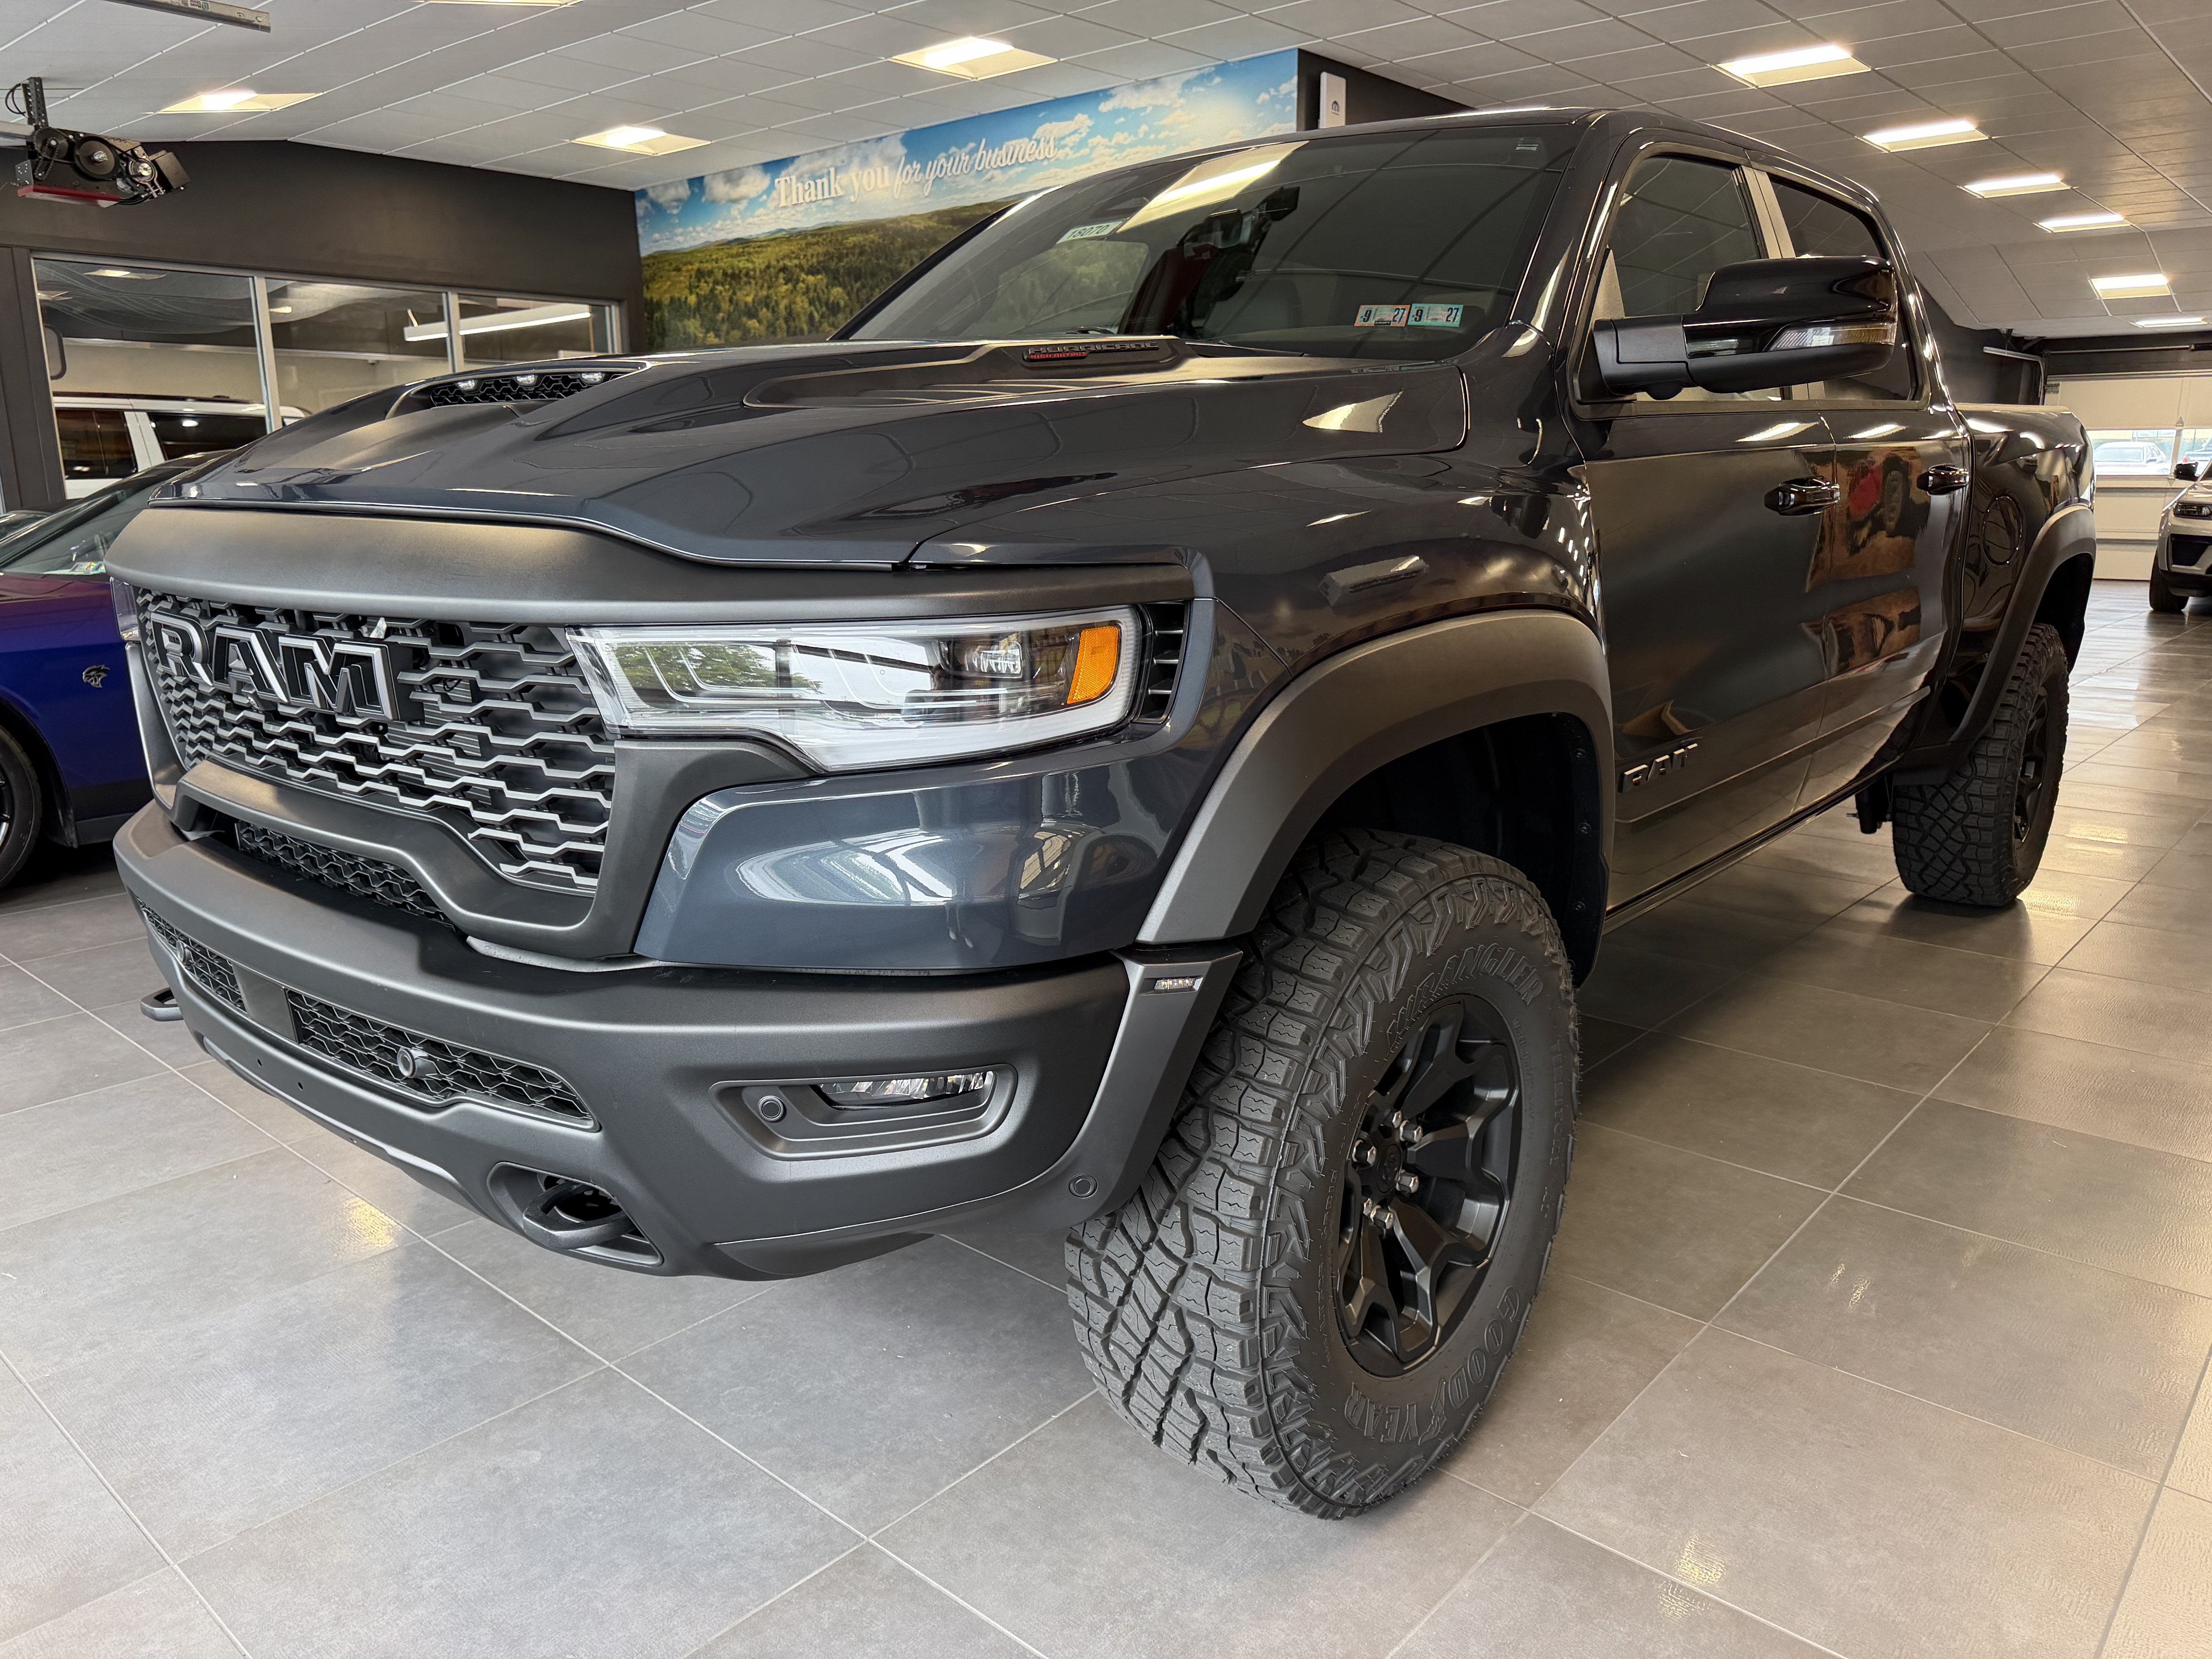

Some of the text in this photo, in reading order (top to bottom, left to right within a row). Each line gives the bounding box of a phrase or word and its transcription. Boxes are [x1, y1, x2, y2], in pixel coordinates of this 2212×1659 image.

[774, 138, 1058, 208] Thank you for your business
[1066, 224, 1110, 239] 18070
[1392, 308, 1407, 323] 27
[1446, 307, 1460, 323] 27
[1028, 342, 1159, 354] HURRICANE
[151, 611, 401, 721] RAM
[1384, 943, 1543, 1060] WRANGLER
